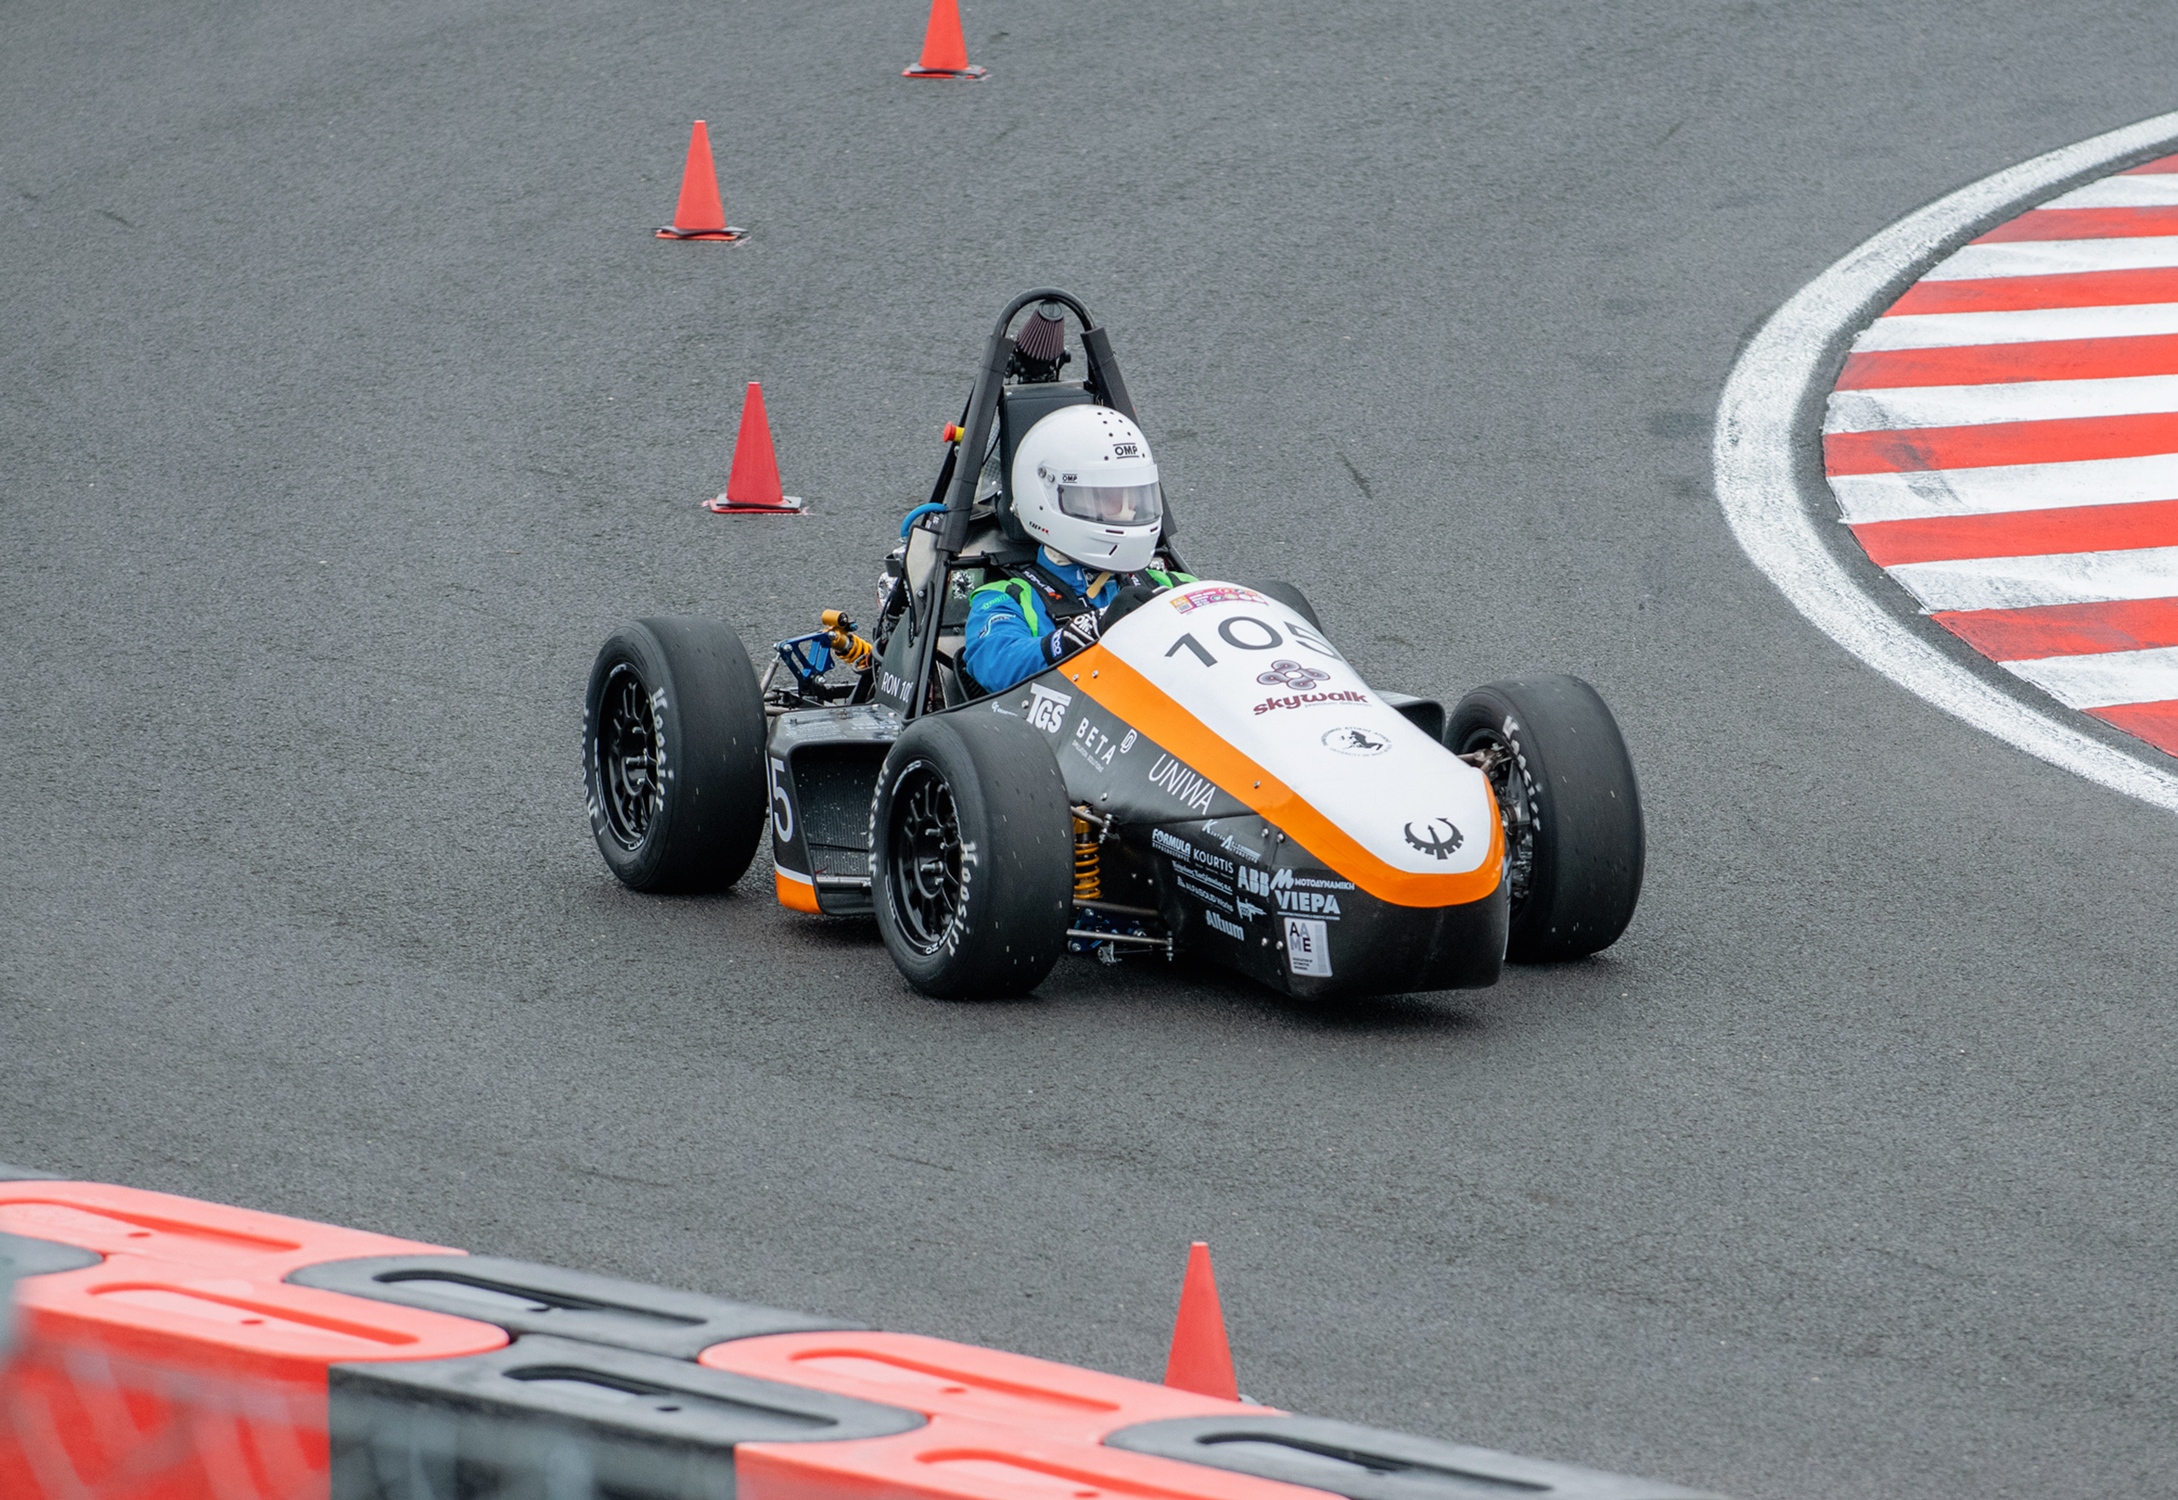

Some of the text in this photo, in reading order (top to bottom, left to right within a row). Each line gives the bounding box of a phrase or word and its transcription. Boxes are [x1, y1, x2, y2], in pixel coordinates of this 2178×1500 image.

[1114, 445, 1138, 456] OMP
[1061, 474, 1078, 482] OMP
[1164, 616, 1343, 668] 105
[1026, 682, 1072, 733] TGS
[1253, 690, 1368, 716] skywalk
[1076, 717, 1116, 765] BETA
[771, 756, 793, 843] 5
[1148, 753, 1216, 815] UNIWA
[1152, 828, 1191, 855] FORMULA
[1193, 848, 1234, 874] KOURTIS
[1237, 865, 1270, 897] ABB
[1274, 890, 1341, 914] VIEPA
[1205, 909, 1245, 941] Altium
